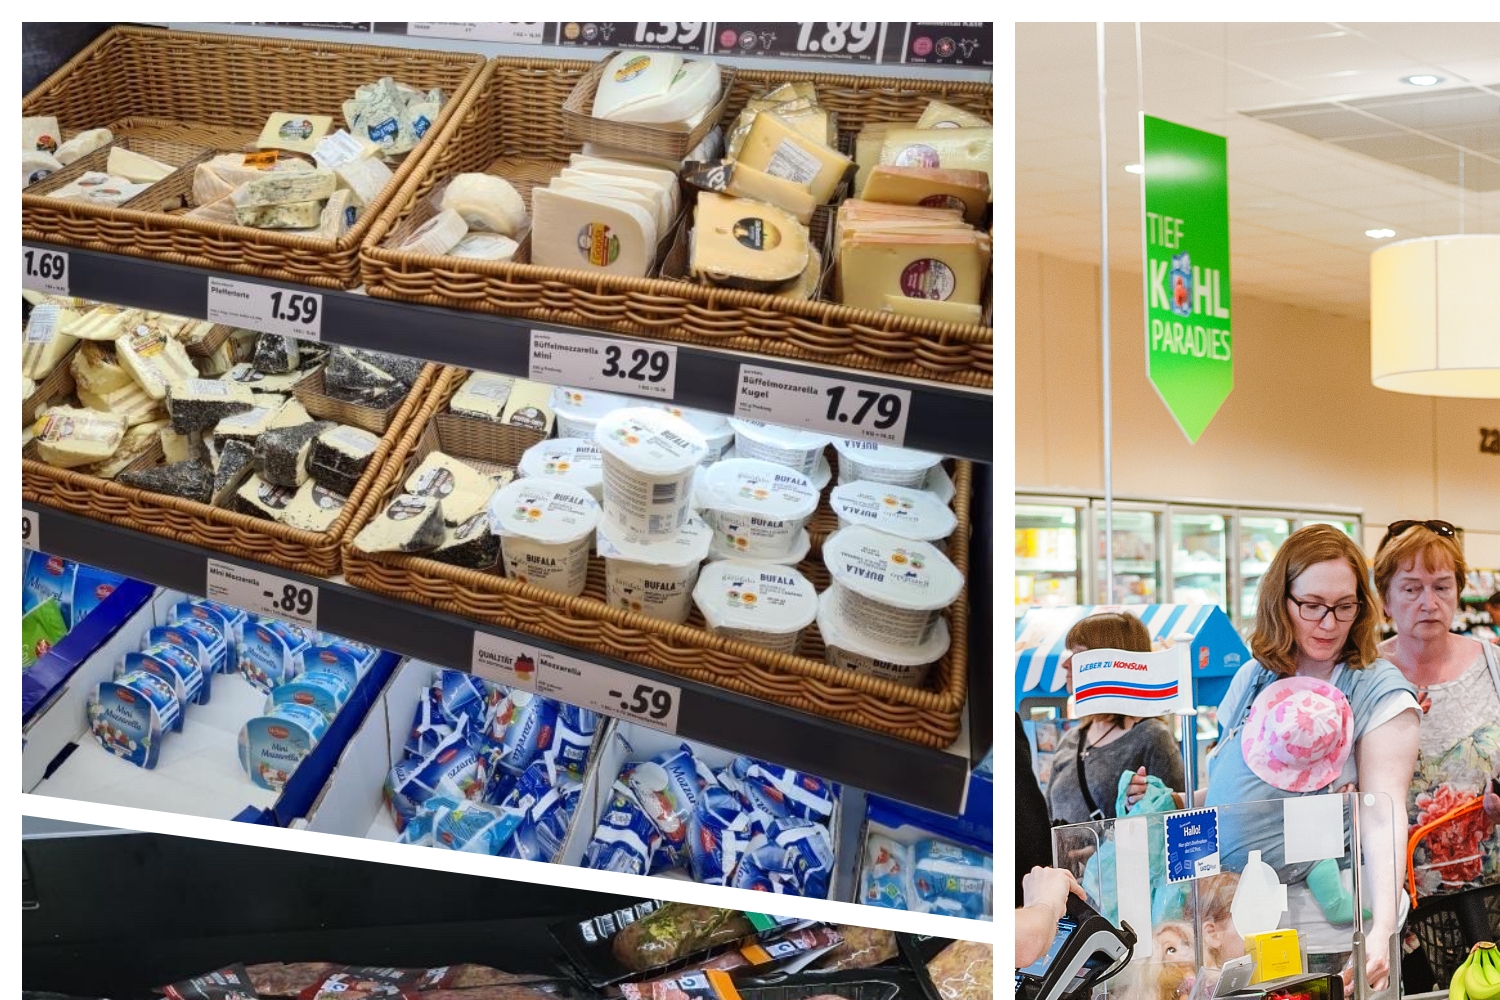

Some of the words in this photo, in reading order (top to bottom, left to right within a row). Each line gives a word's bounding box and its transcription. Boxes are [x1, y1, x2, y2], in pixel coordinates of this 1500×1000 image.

[797, 22, 876, 53] 1.89
[1146, 212, 1184, 250] TIEF
[24, 250, 65, 281] 1.69
[1149, 252, 1230, 319] KHL
[271, 291, 318, 325] 1.59
[533, 340, 599, 356] Büffelmozzarella
[533, 351, 552, 361] Mini
[1151, 319, 1231, 362] PARADIES
[602, 345, 669, 383] 3.29
[741, 386, 770, 401] Kugel
[743, 376, 819, 396] Büffelmozzarella
[825, 385, 902, 429] 1.79
[760, 573, 795, 587] BUFALA
[262, 584, 313, 616] -.89
[478, 649, 514, 666] QUALITÄT
[540, 658, 582, 677] Mozzarella
[1103, 661, 1112, 669] ZU
[1113, 660, 1149, 672] KONSUM
[608, 684, 672, 719] -.59
[1183, 824, 1202, 837] Hallo!
